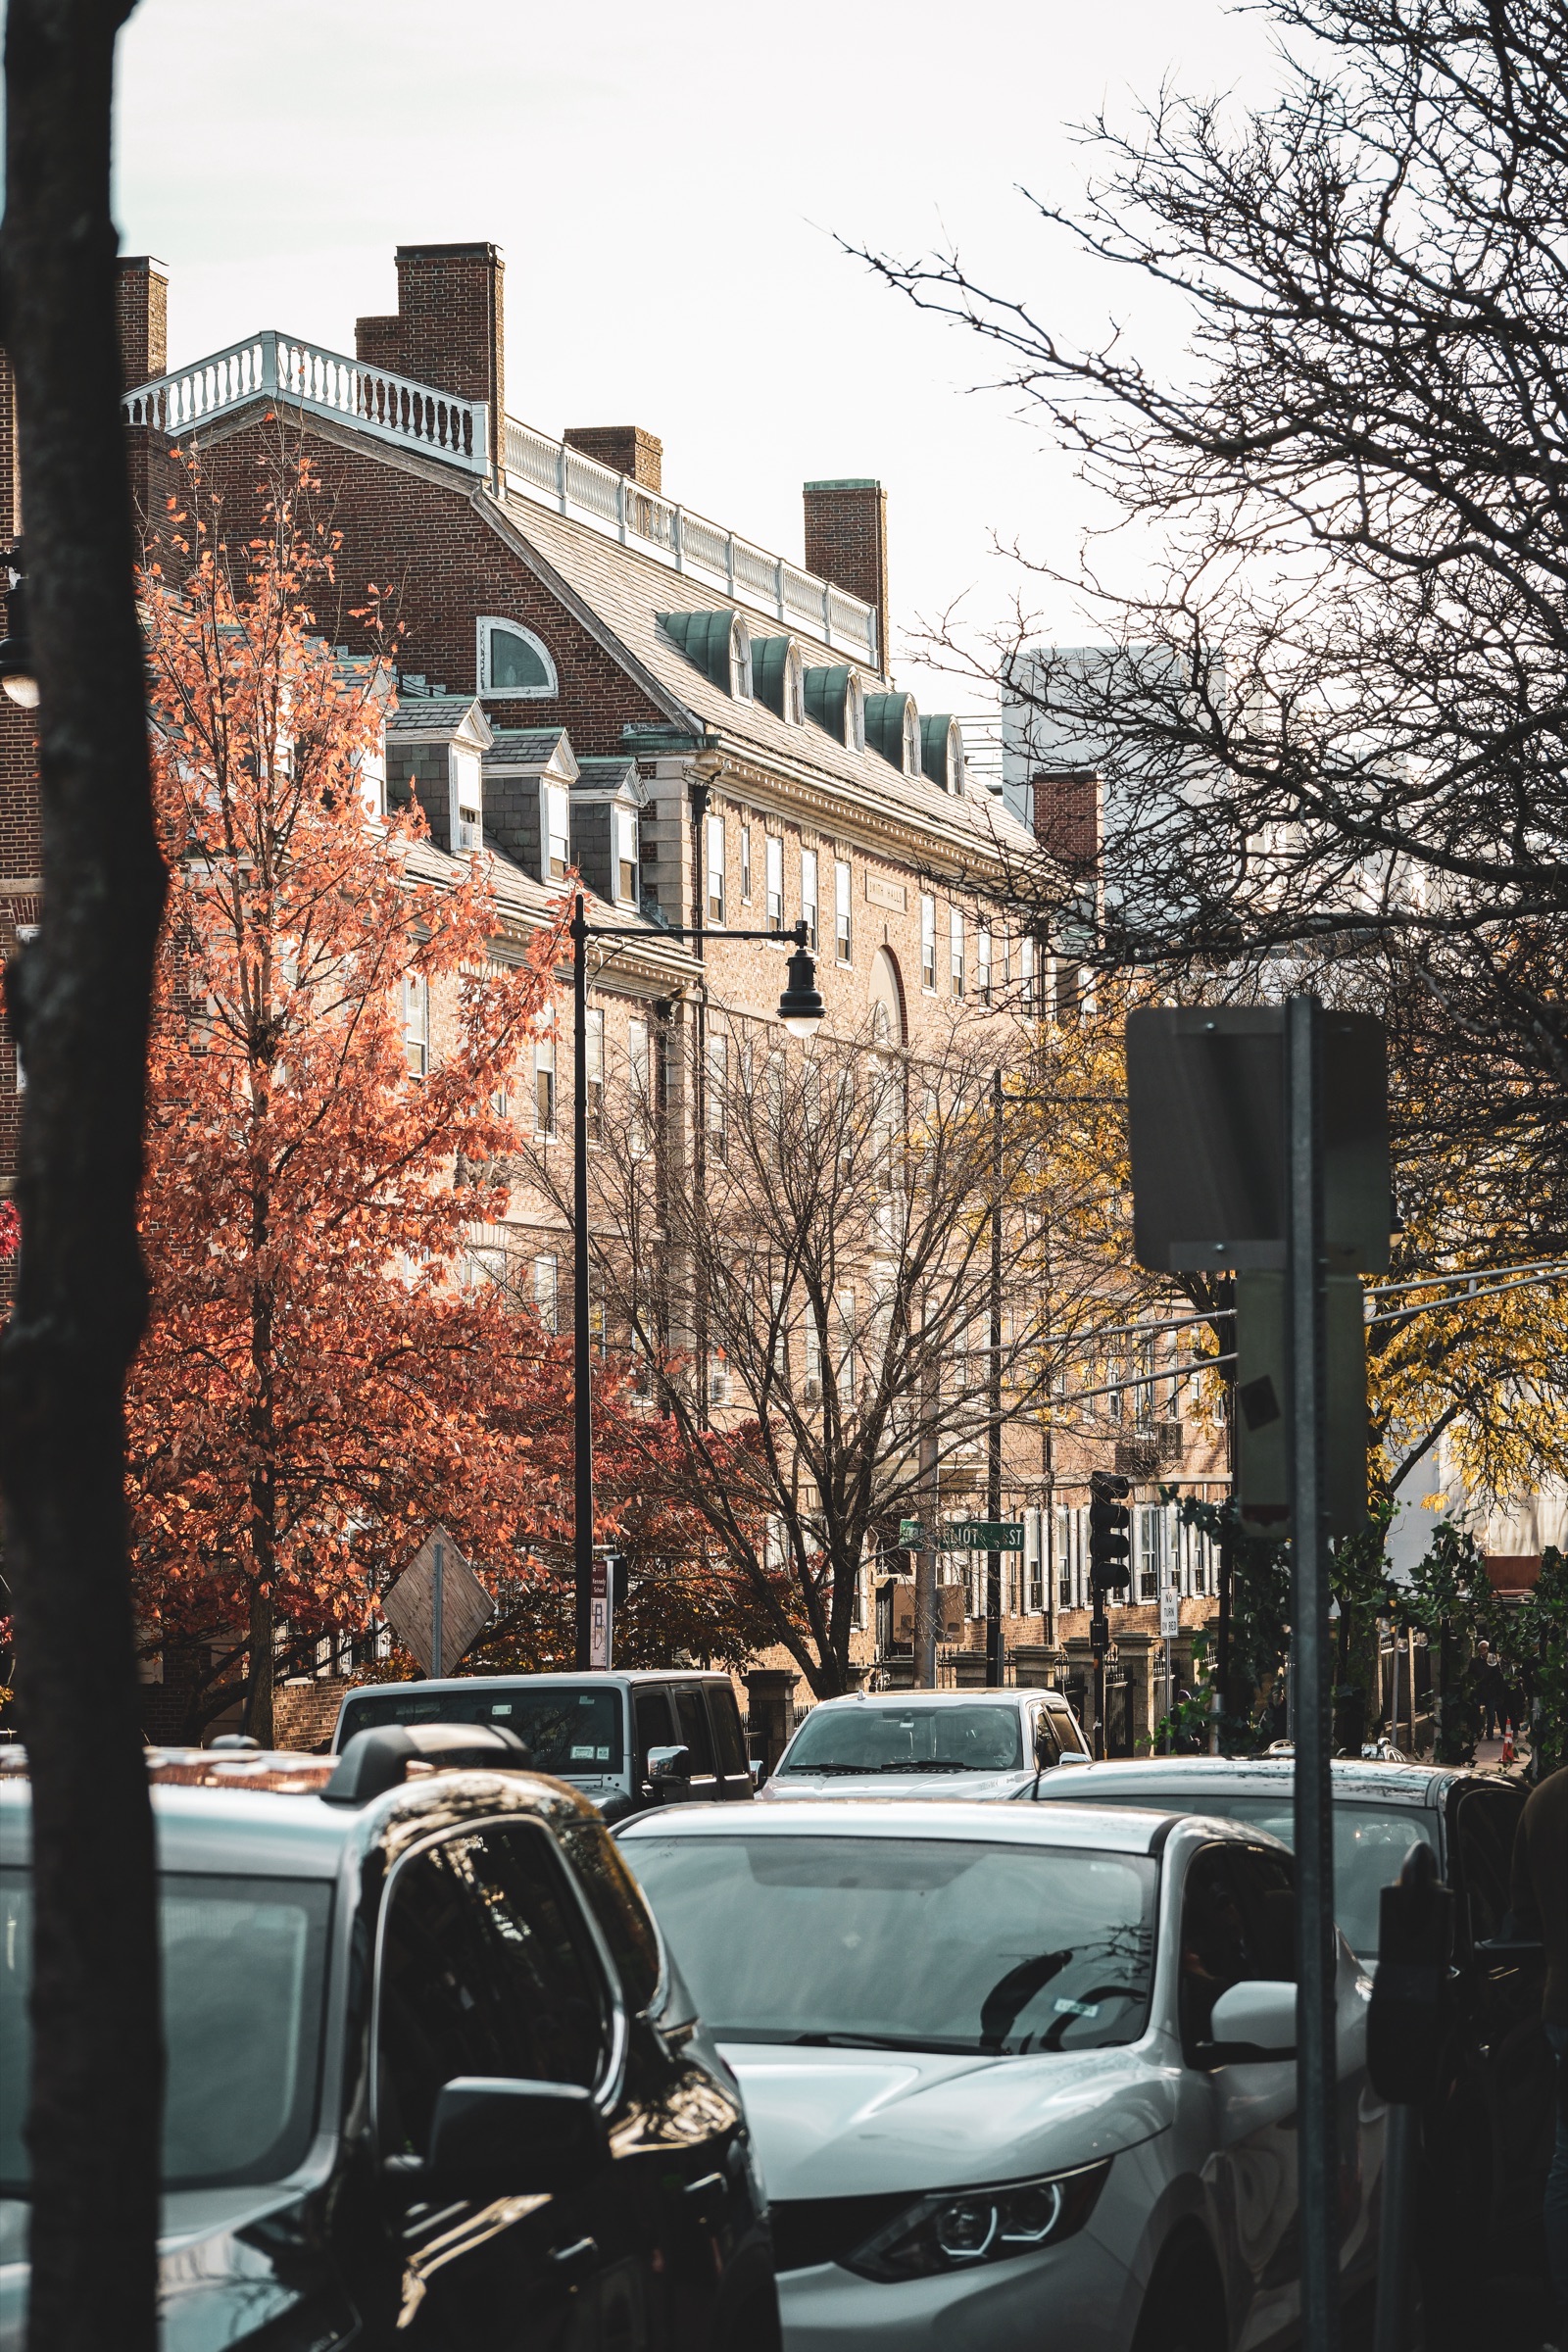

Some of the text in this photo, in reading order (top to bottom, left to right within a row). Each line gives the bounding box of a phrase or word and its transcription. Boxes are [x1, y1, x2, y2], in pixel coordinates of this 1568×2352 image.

[1008, 1529, 1022, 1545] ST
[1165, 1593, 1172, 1603] NO
[1163, 1607, 1174, 1617] TURN
[1162, 1621, 1167, 1631] ON
